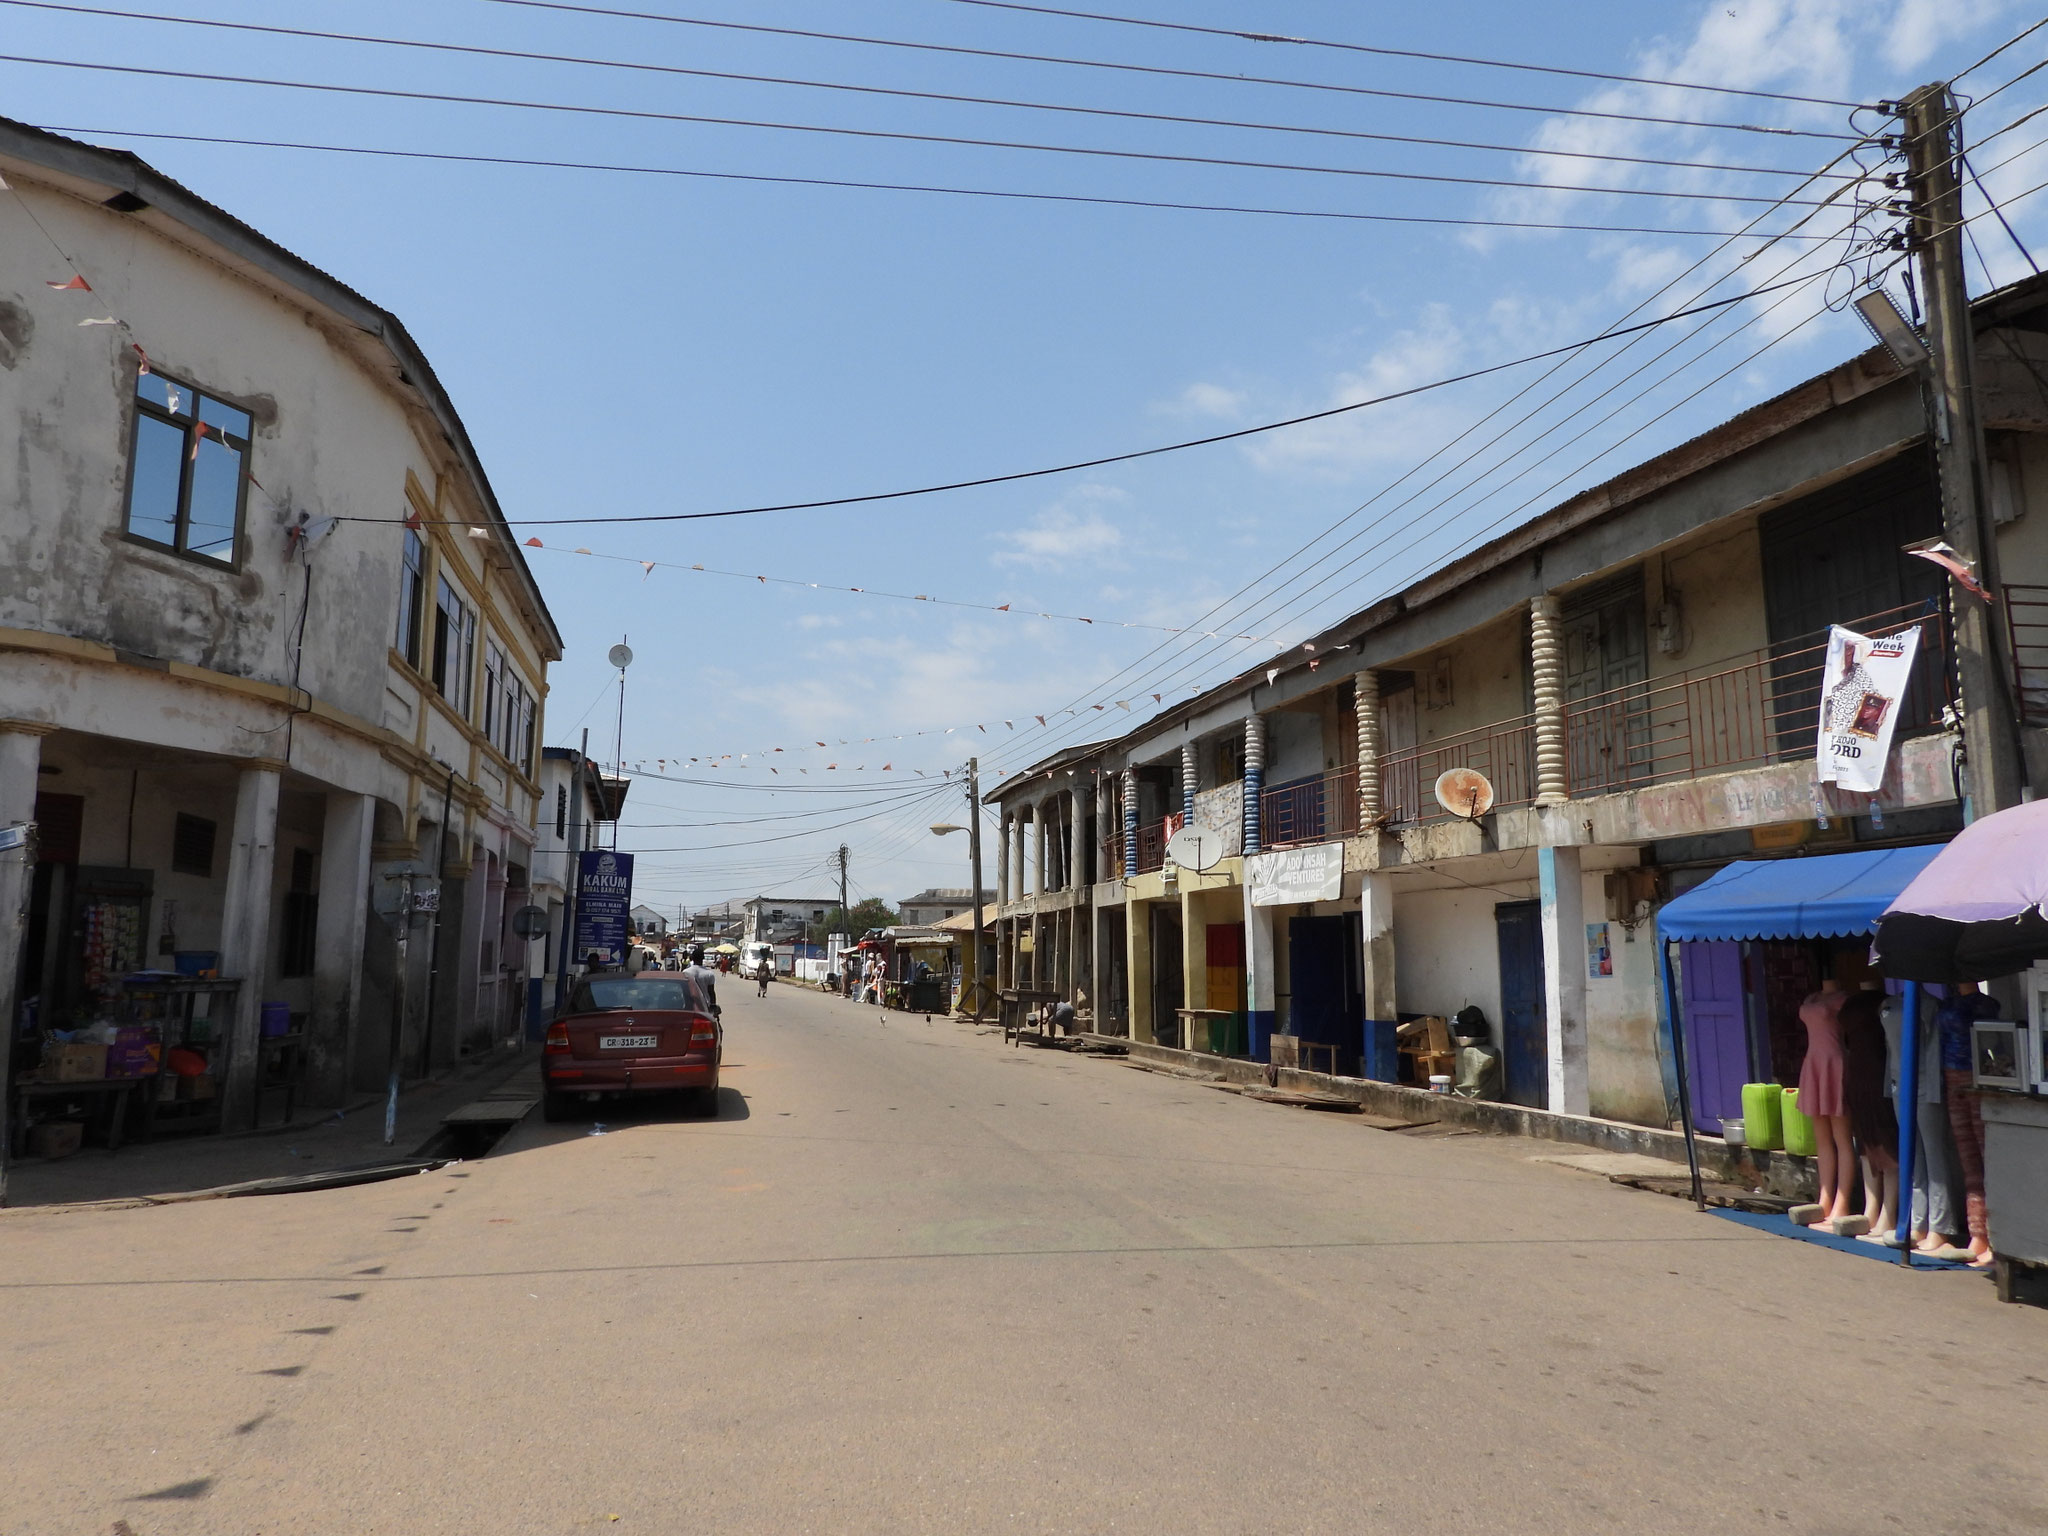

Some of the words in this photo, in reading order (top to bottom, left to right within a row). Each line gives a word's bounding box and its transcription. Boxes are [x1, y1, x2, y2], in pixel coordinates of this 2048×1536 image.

[1873, 640, 1905, 651] Week
[583, 874, 628, 889] KAKUM
[1289, 867, 1325, 885] VENTURES
[606, 1038, 617, 1047] CR
[620, 1037, 649, 1047] 318-23
